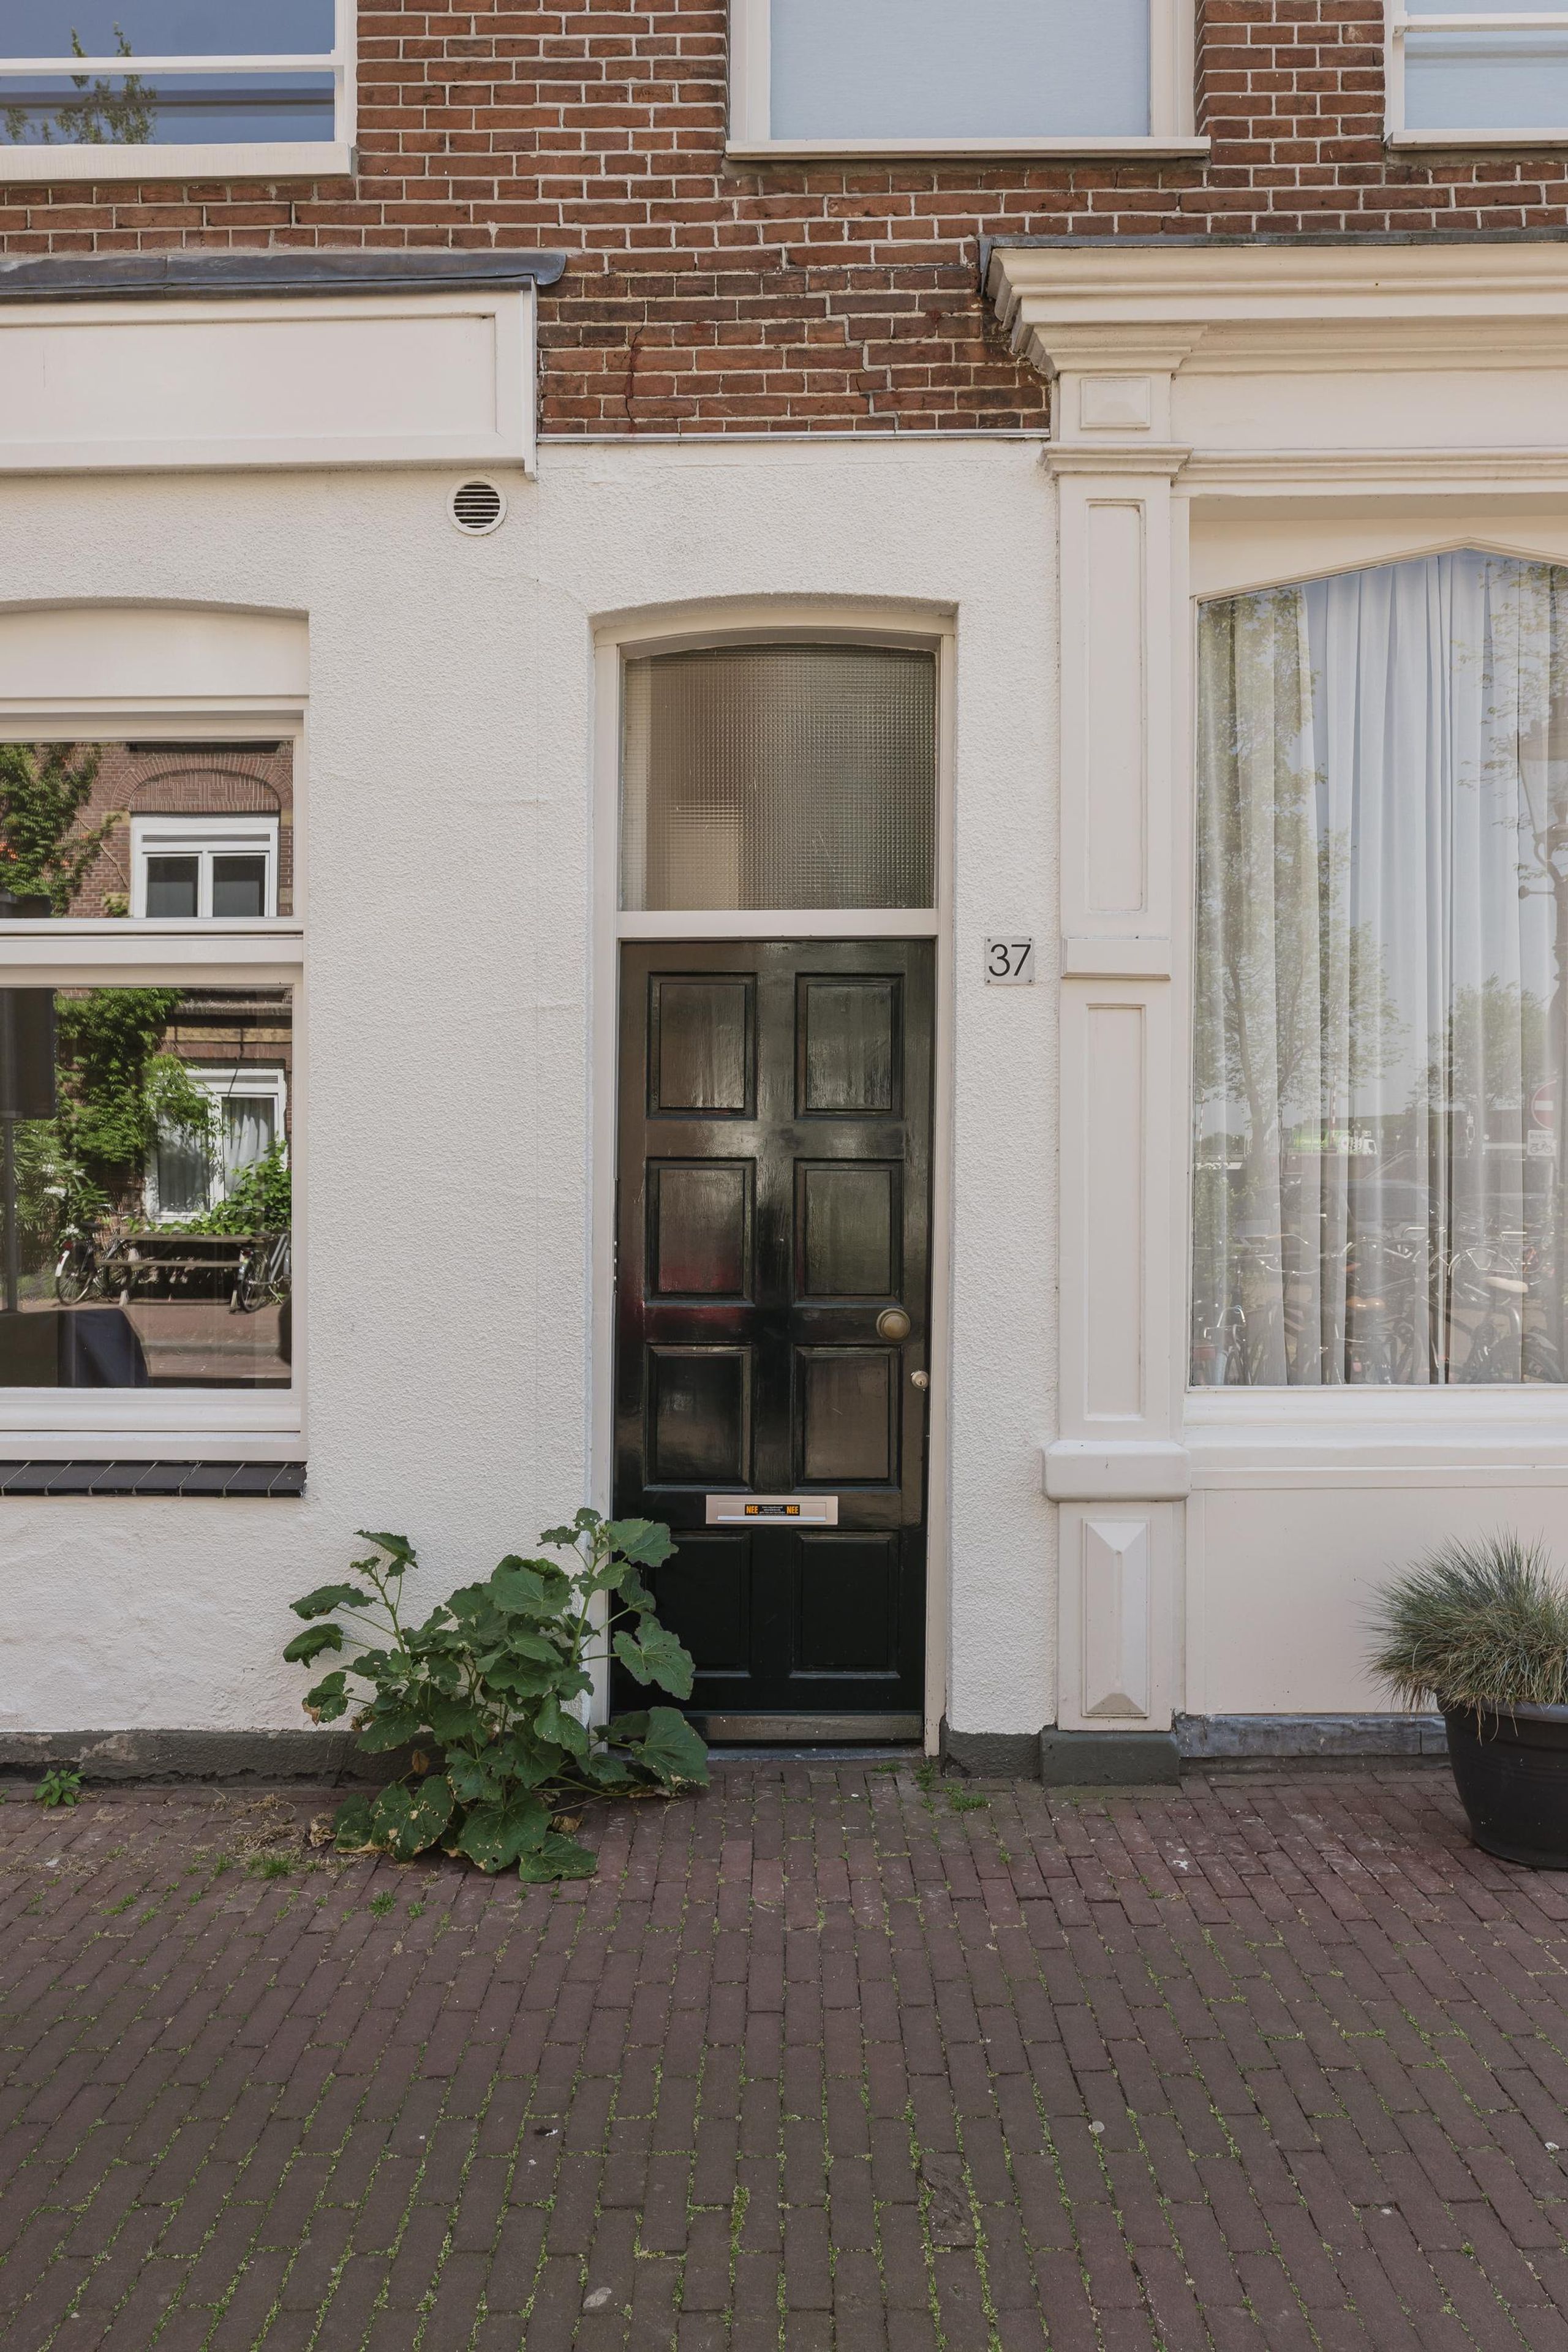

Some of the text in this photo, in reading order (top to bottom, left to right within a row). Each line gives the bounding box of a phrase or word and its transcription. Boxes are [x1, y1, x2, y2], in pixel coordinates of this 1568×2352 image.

[989, 944, 1031, 976] 37
[746, 1506, 758, 1514] NEE
[786, 1506, 799, 1514] NEE
